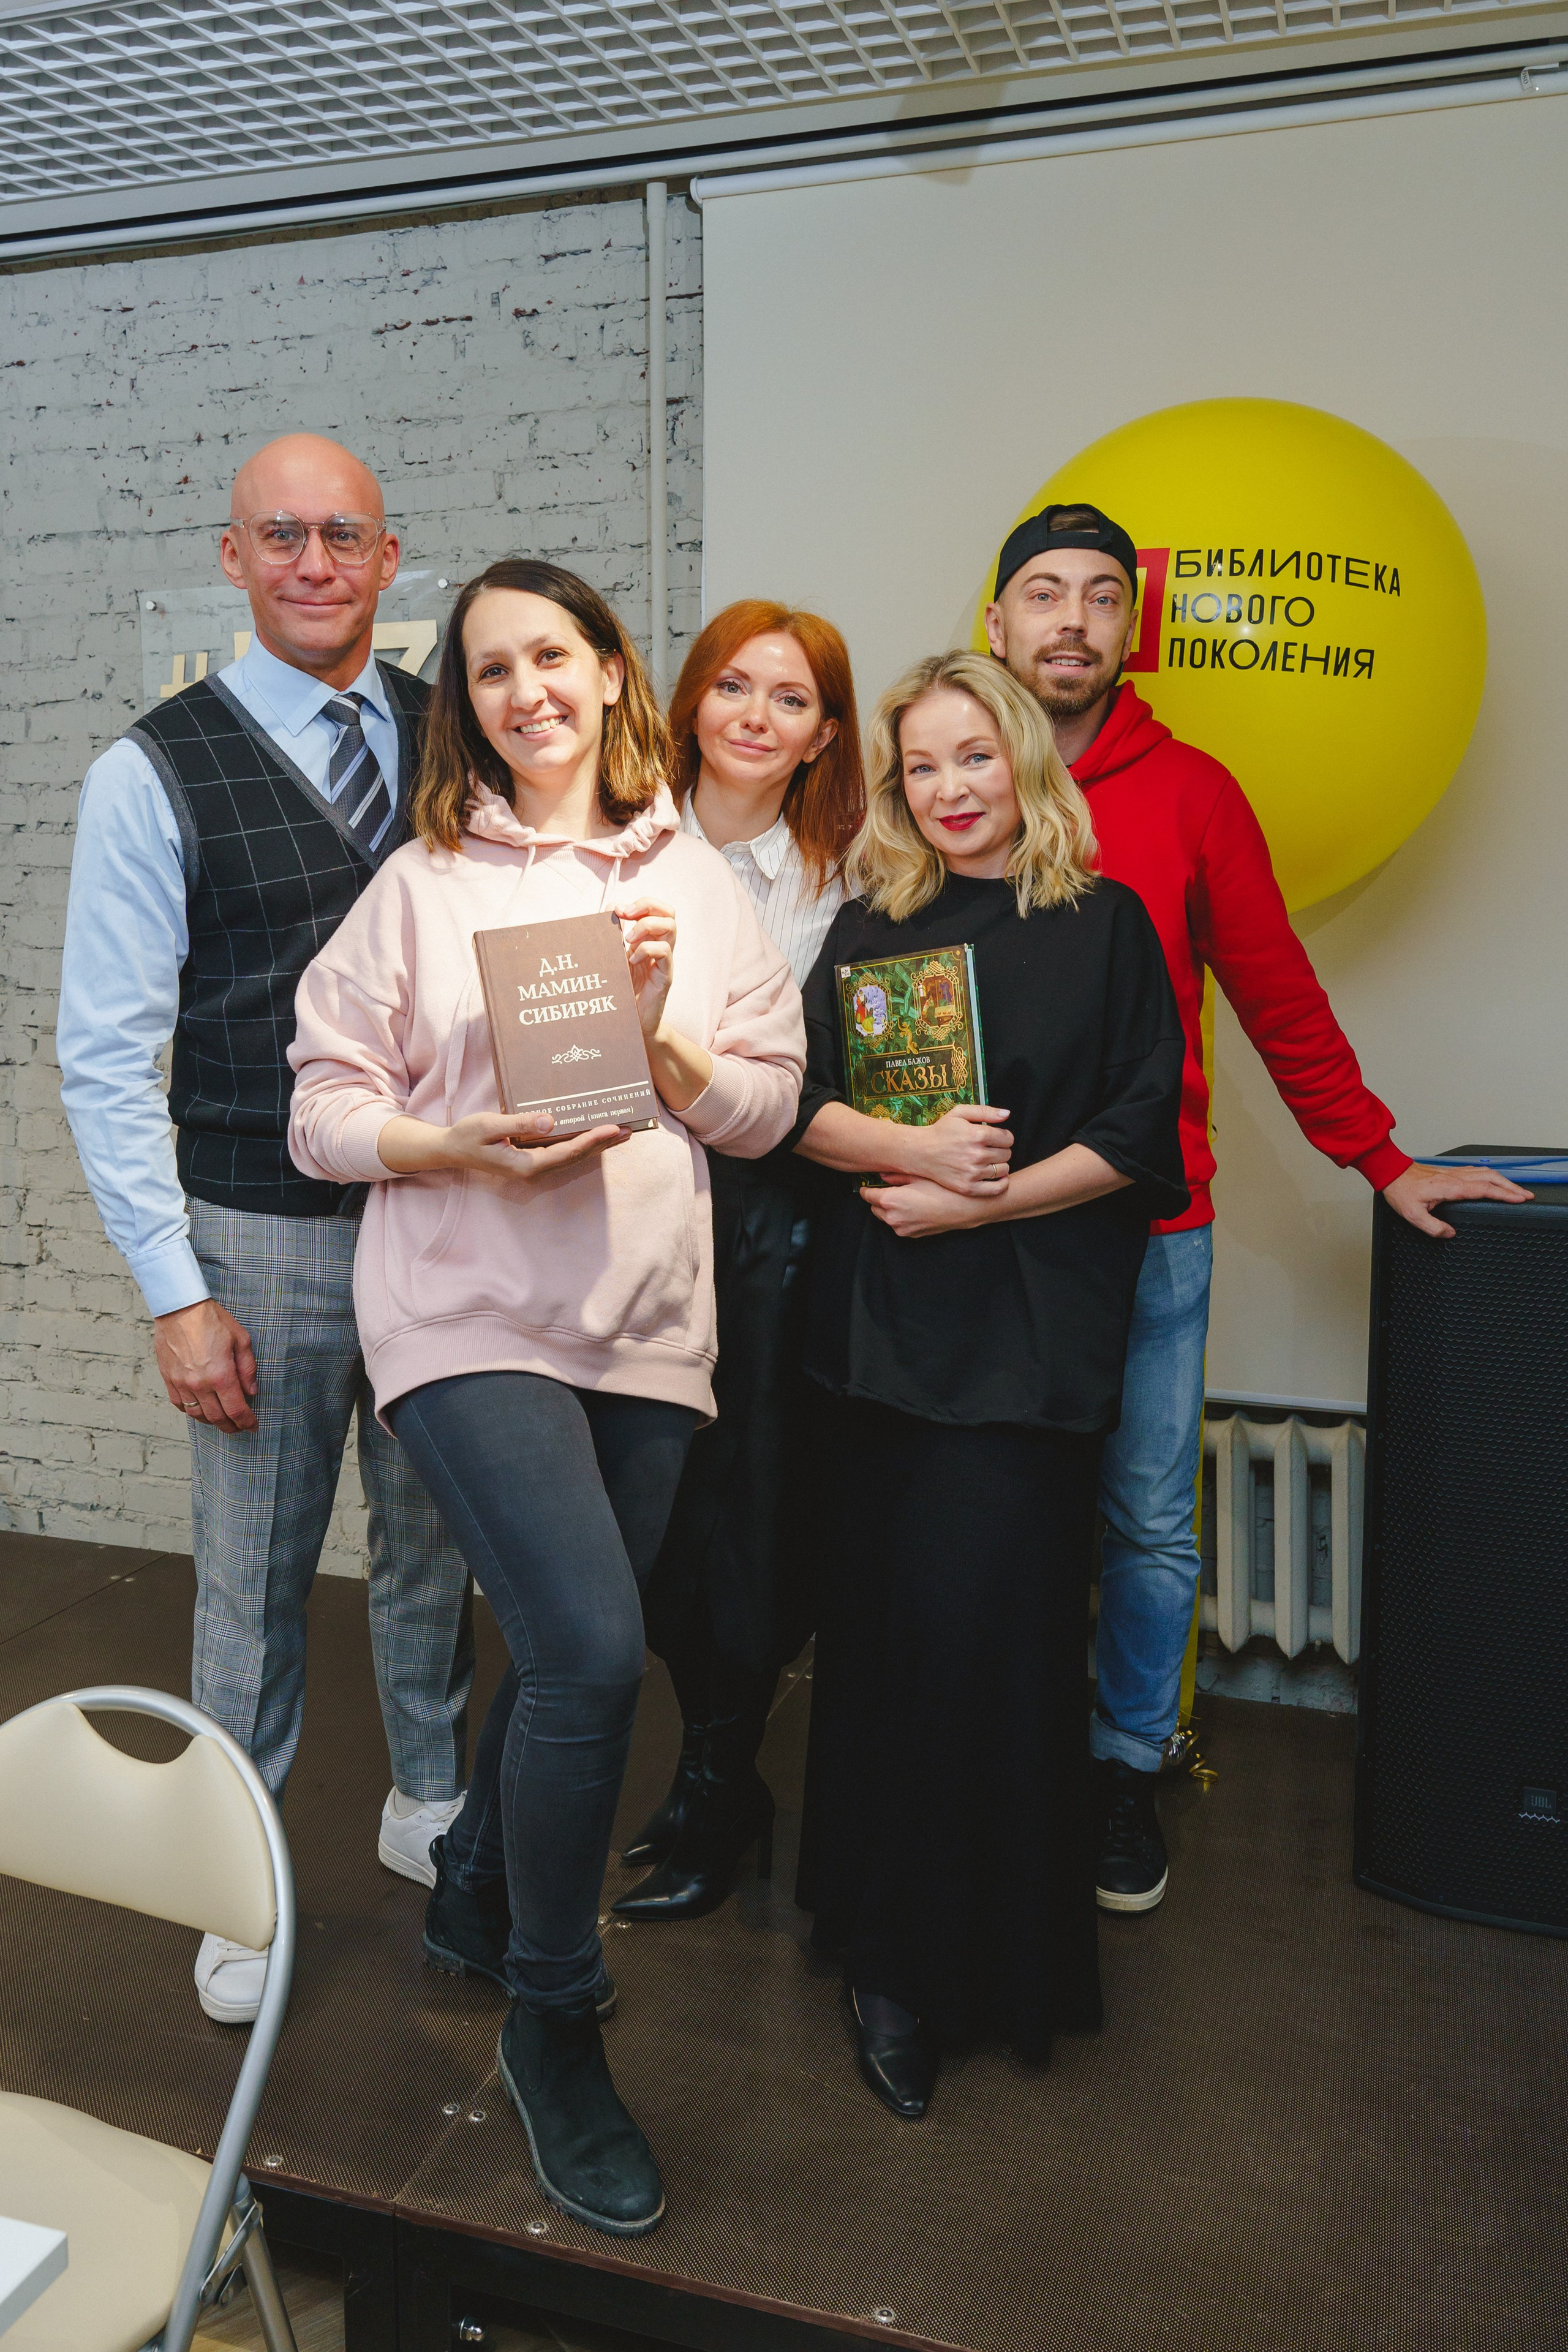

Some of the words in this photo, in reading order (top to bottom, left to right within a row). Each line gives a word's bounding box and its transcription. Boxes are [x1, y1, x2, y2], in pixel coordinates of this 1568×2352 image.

[1175, 548, 1401, 597] БИБЛИОТЕКА
[1170, 592, 1314, 627] НОВОГО
[1168, 637, 1375, 679] ПОКОЛЕНИЯ
[539, 954, 579, 978] Д.Н.
[517, 973, 608, 1001] МАМИН-
[519, 995, 617, 1025] СИБИРЯК
[886, 1059, 907, 1068] ПАВЕЛ
[907, 1056, 930, 1066] БАЖОВ
[870, 1064, 949, 1094] СКАЗЫ
[556, 1099, 598, 1112] СОБРАНИЕ
[602, 1088, 651, 1104] СОЧИНЕНИЙ
[560, 1114, 585, 1125] второй
[588, 1112, 608, 1121] (книга
[611, 1106, 635, 1117] первая)
[1531, 1795, 1551, 1809] JBL
